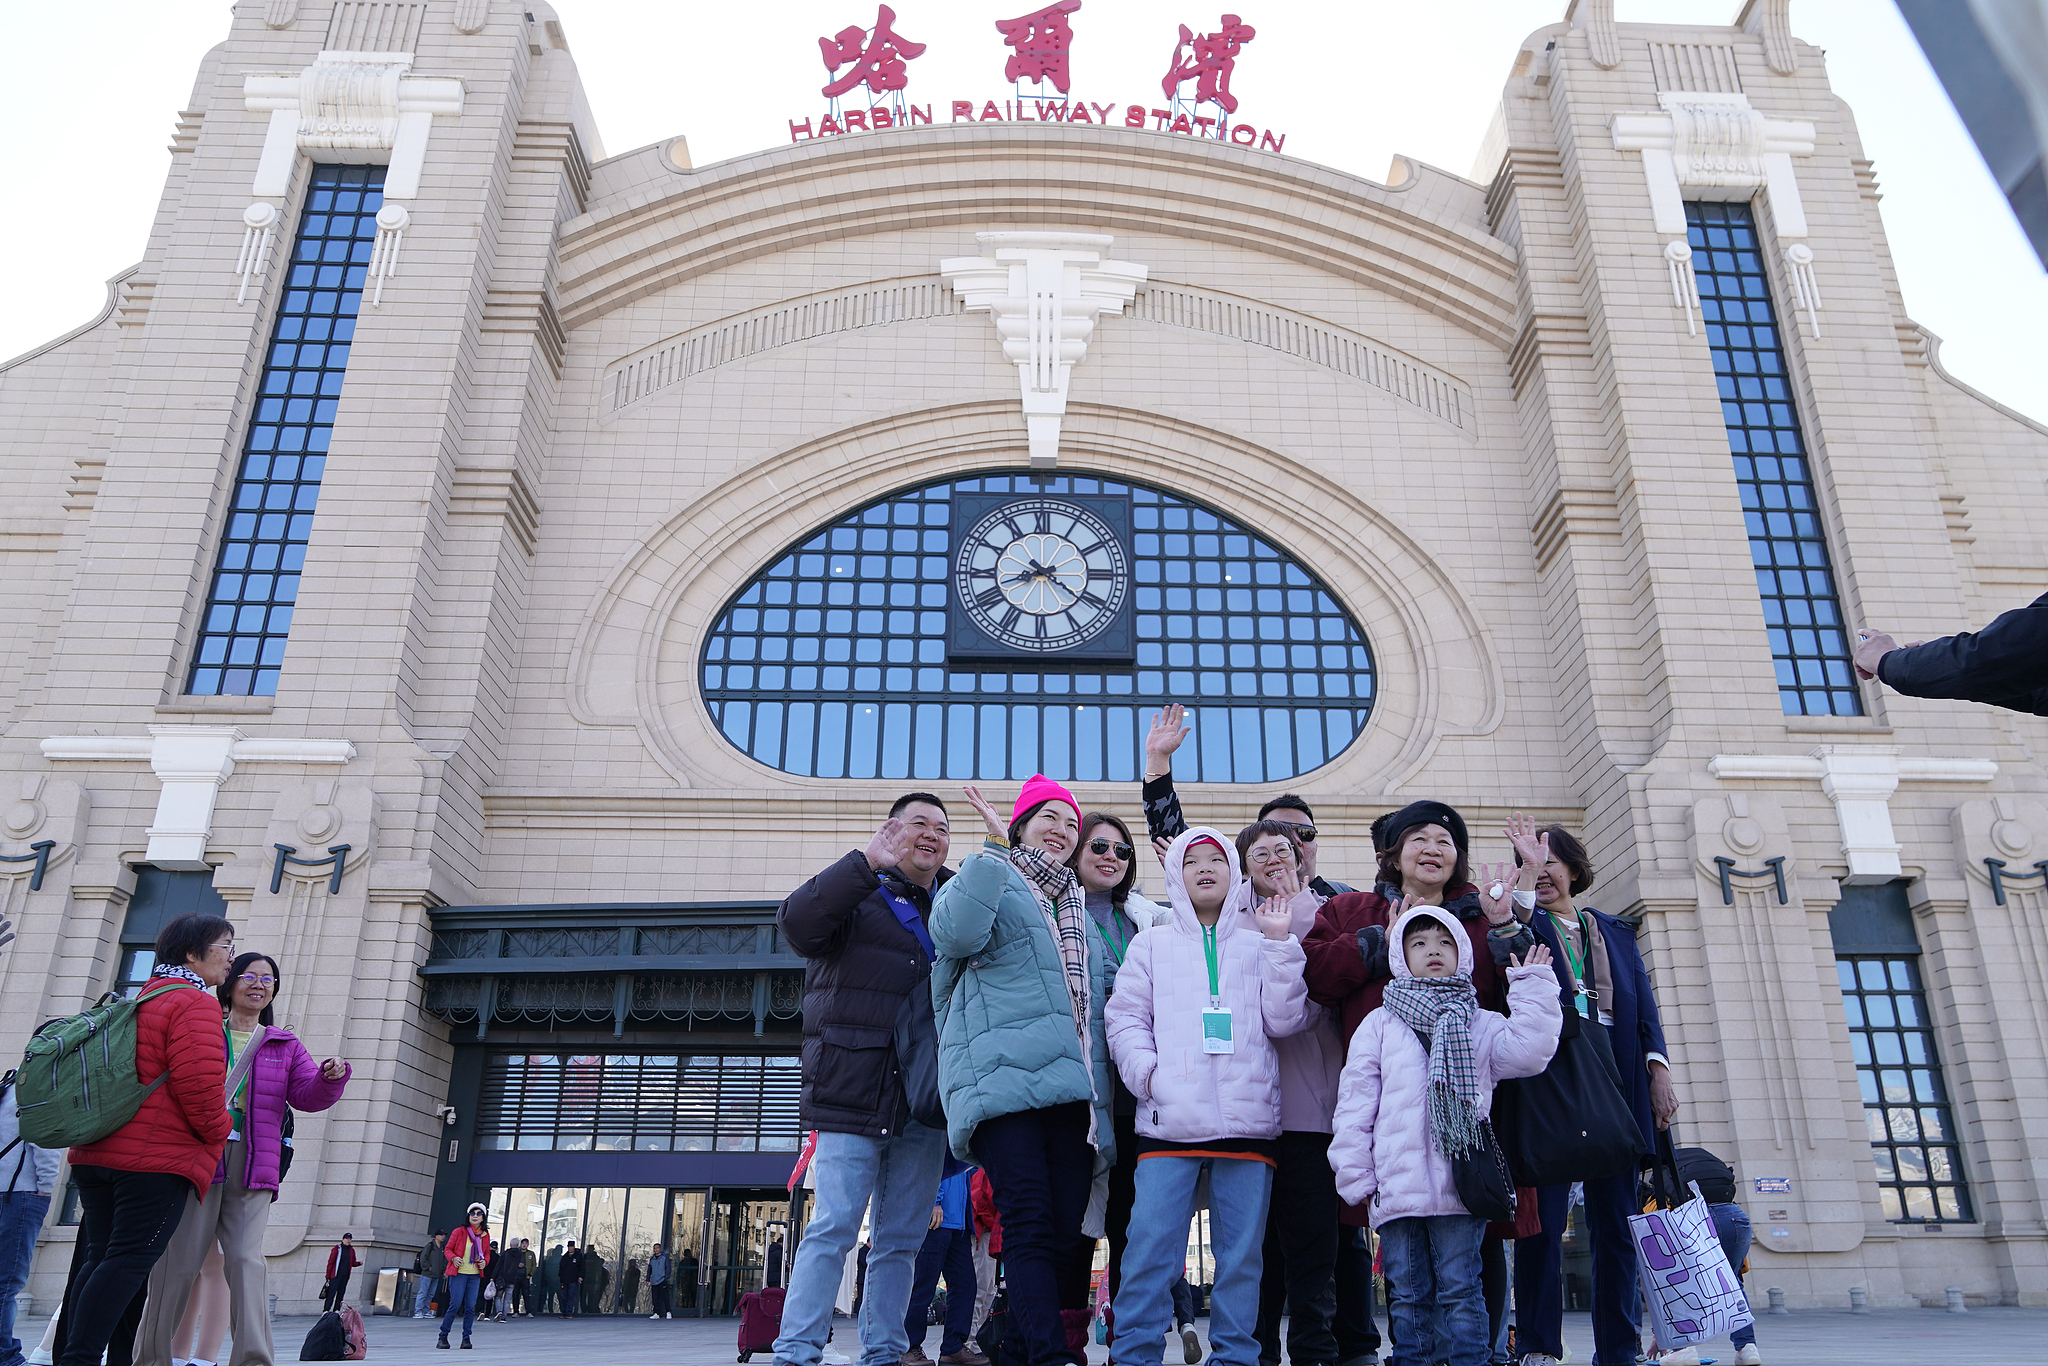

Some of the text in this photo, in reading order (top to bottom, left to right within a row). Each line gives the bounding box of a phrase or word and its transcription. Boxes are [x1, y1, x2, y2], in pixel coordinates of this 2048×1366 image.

[789, 100, 1286, 153] HARBIN RAILWAY STATION
[1003, 516, 1024, 540] XI
[1034, 511, 1051, 534] XII
[979, 539, 1004, 556] X
[1081, 540, 1107, 557] II
[971, 566, 997, 579] IX
[1088, 568, 1113, 581] III
[1000, 605, 1022, 632] VII
[1036, 615, 1048, 638] VI
